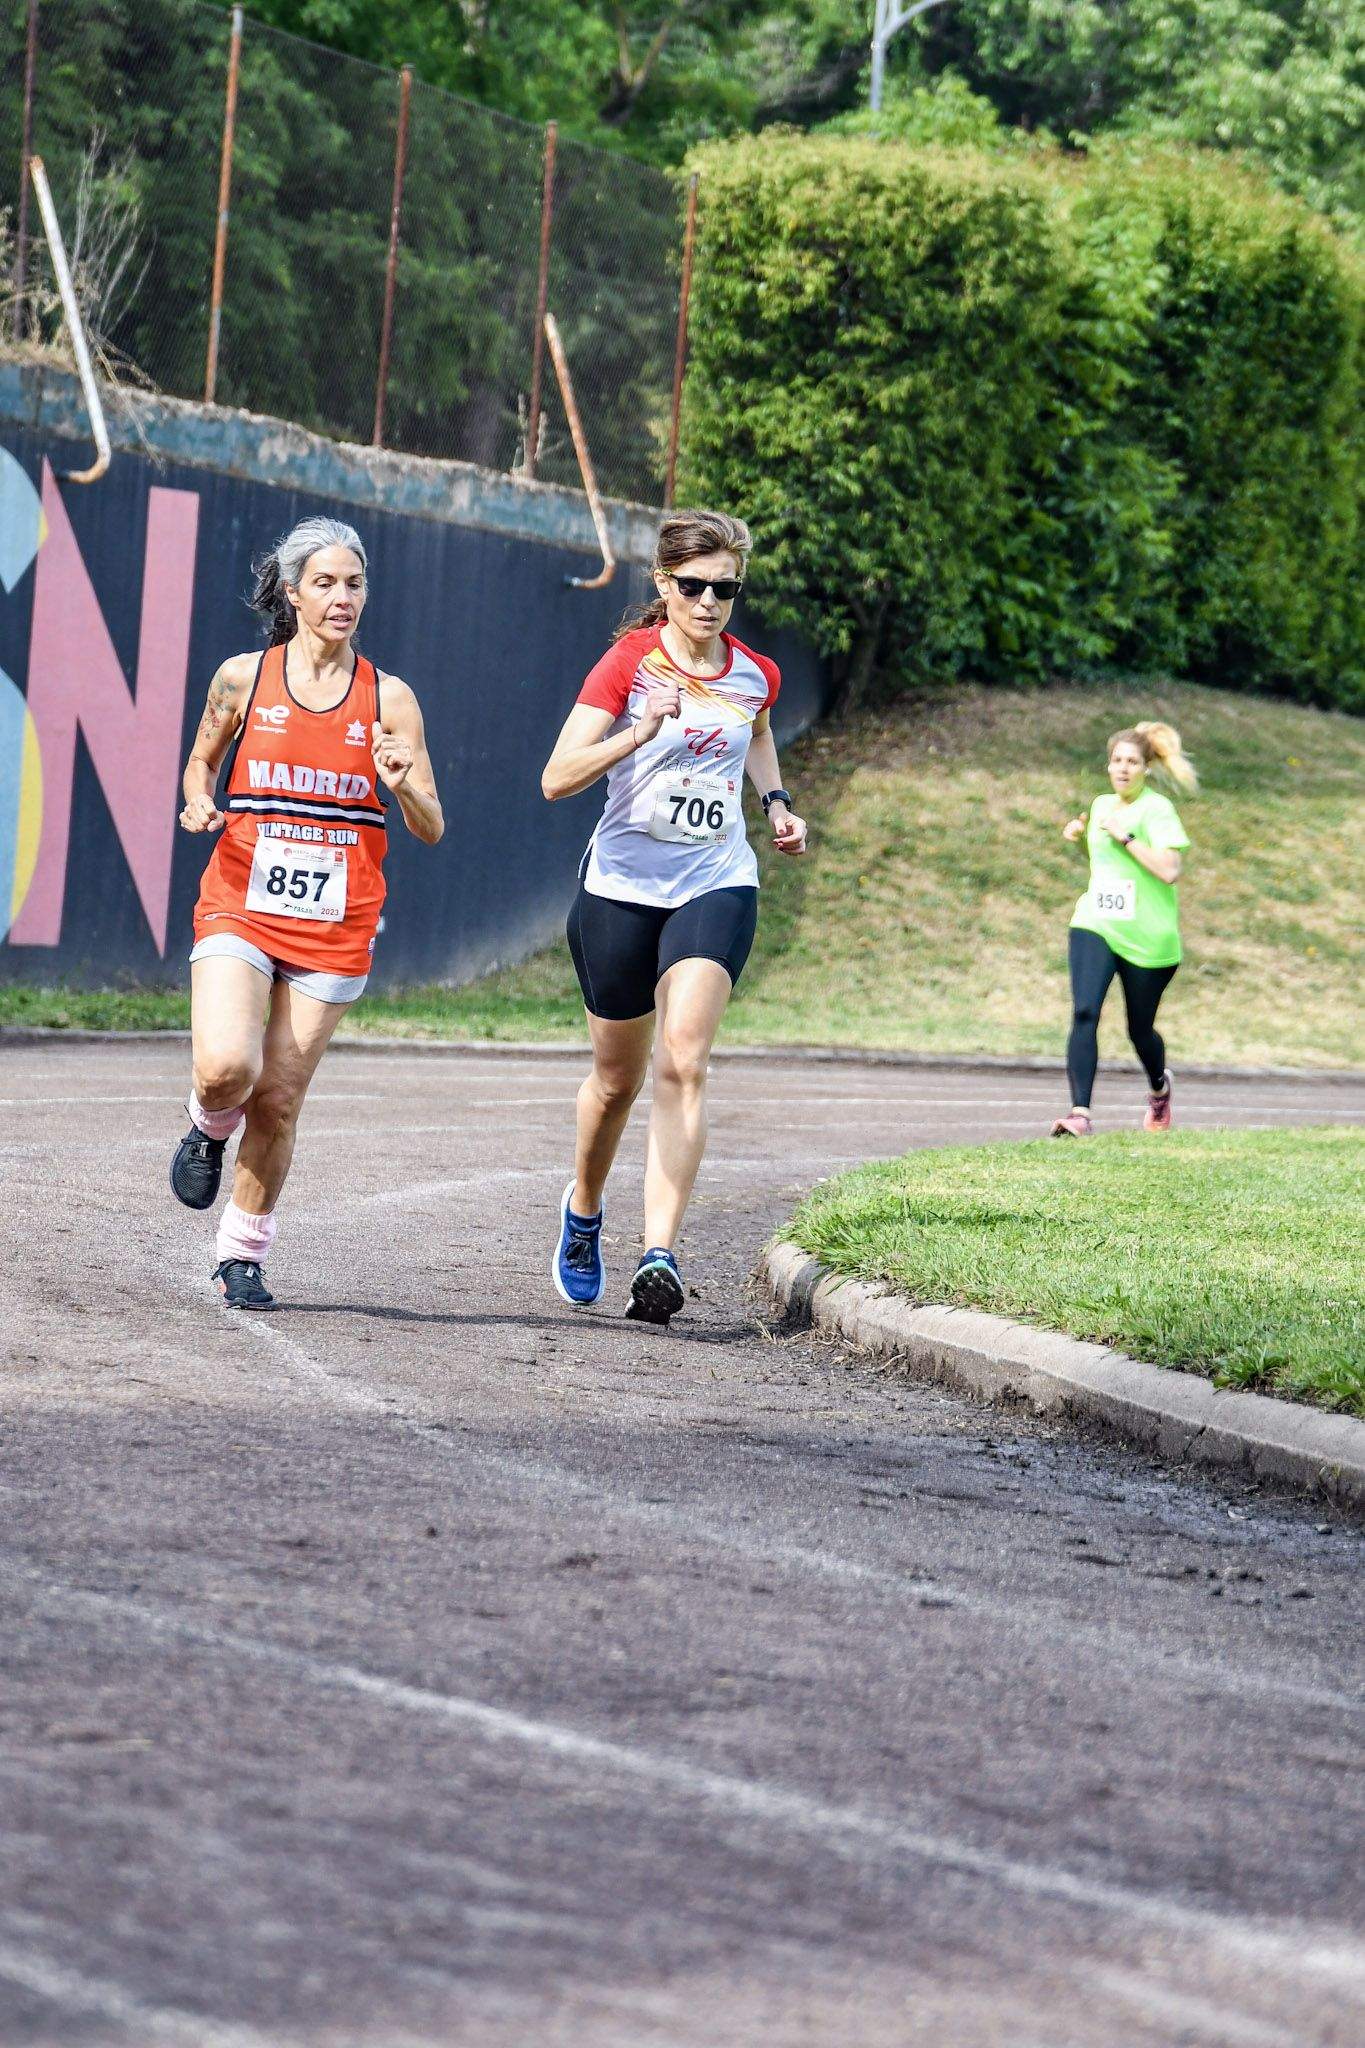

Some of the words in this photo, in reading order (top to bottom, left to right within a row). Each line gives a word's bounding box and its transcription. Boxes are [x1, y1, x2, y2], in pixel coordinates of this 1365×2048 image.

[247, 759, 370, 800] MADRID
[669, 795, 725, 830] 706
[256, 822, 324, 841] VINTAGE
[328, 829, 359, 845] RUN
[266, 865, 331, 902] 857
[320, 907, 340, 916] 2023
